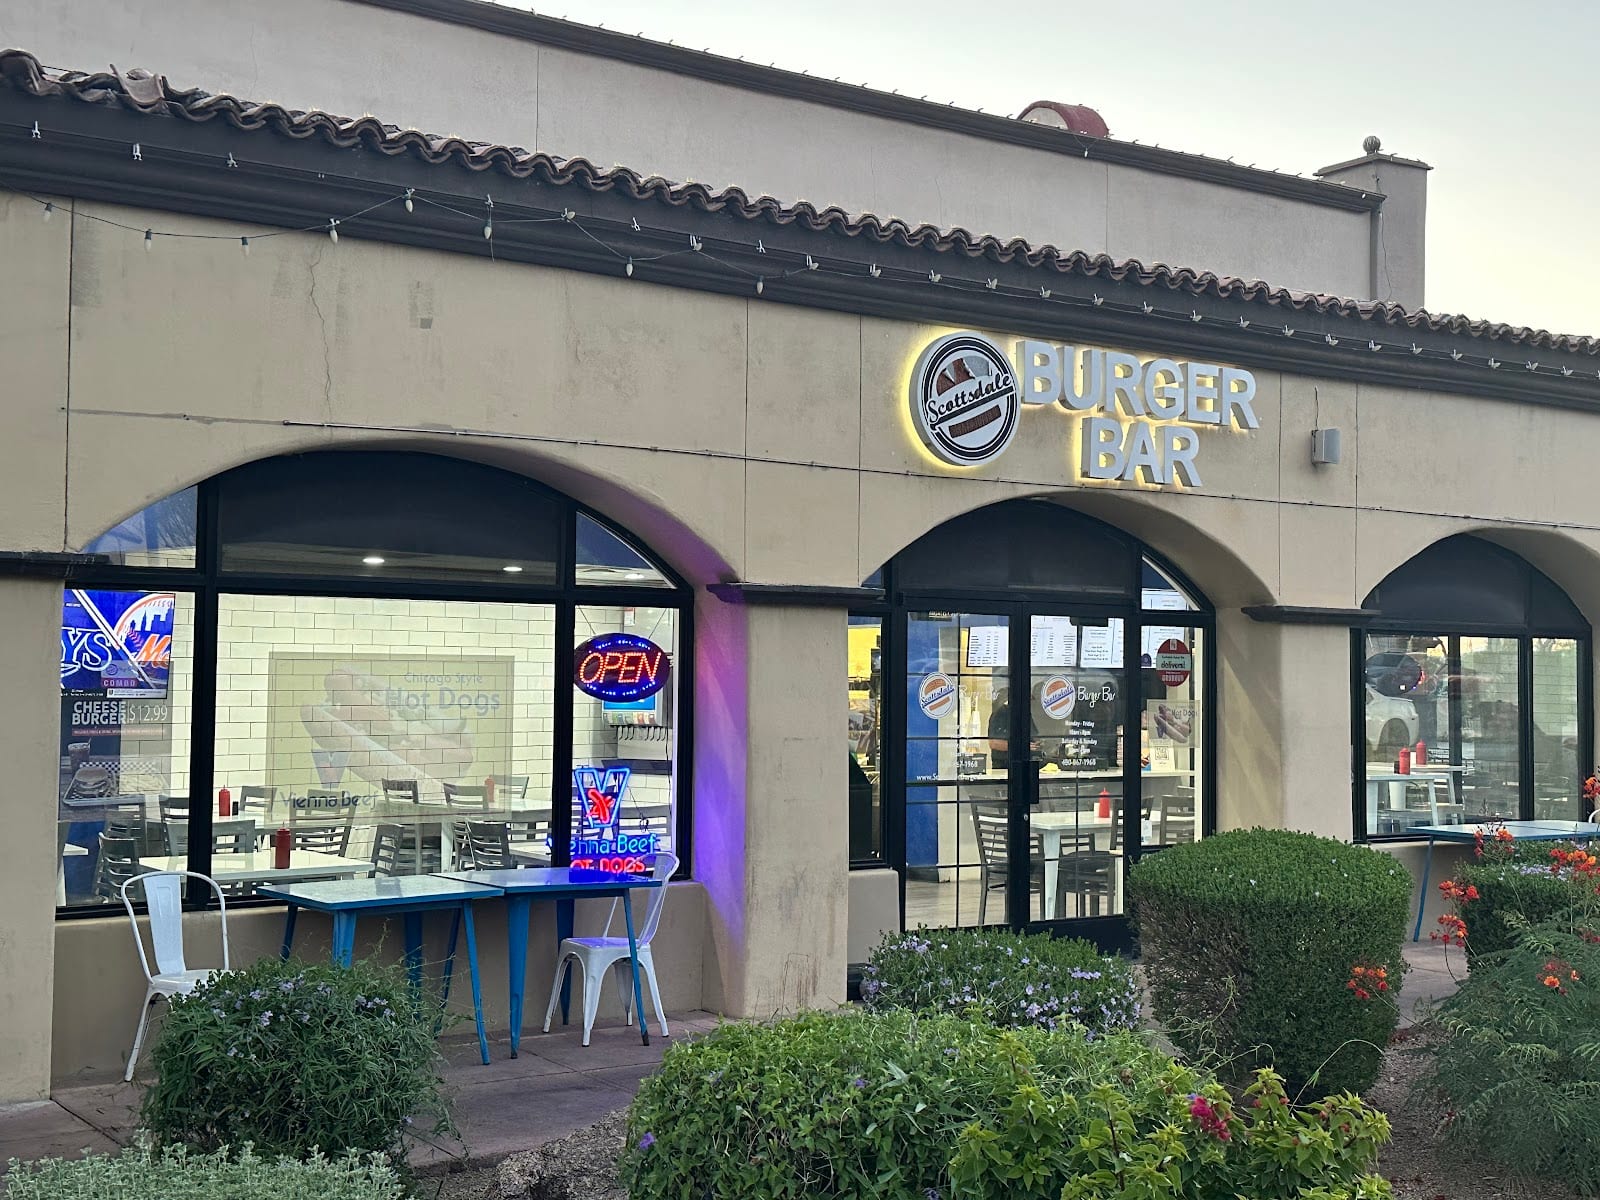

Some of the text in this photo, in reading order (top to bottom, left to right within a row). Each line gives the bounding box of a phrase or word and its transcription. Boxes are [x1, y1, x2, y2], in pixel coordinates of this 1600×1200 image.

[1017, 341, 1260, 429] BURGER
[927, 373, 1012, 424] Scottsdale
[1083, 416, 1202, 487] BAR
[579, 651, 662, 684] OPEN
[404, 672, 483, 686] Chicago Style
[73, 701, 126, 714] CHEESE
[385, 687, 500, 717] Hot Dogs
[72, 713, 127, 725] BURGER
[129, 704, 168, 722] $12.99
[280, 790, 379, 810] Vienna Beef
[617, 833, 657, 854] Beef
